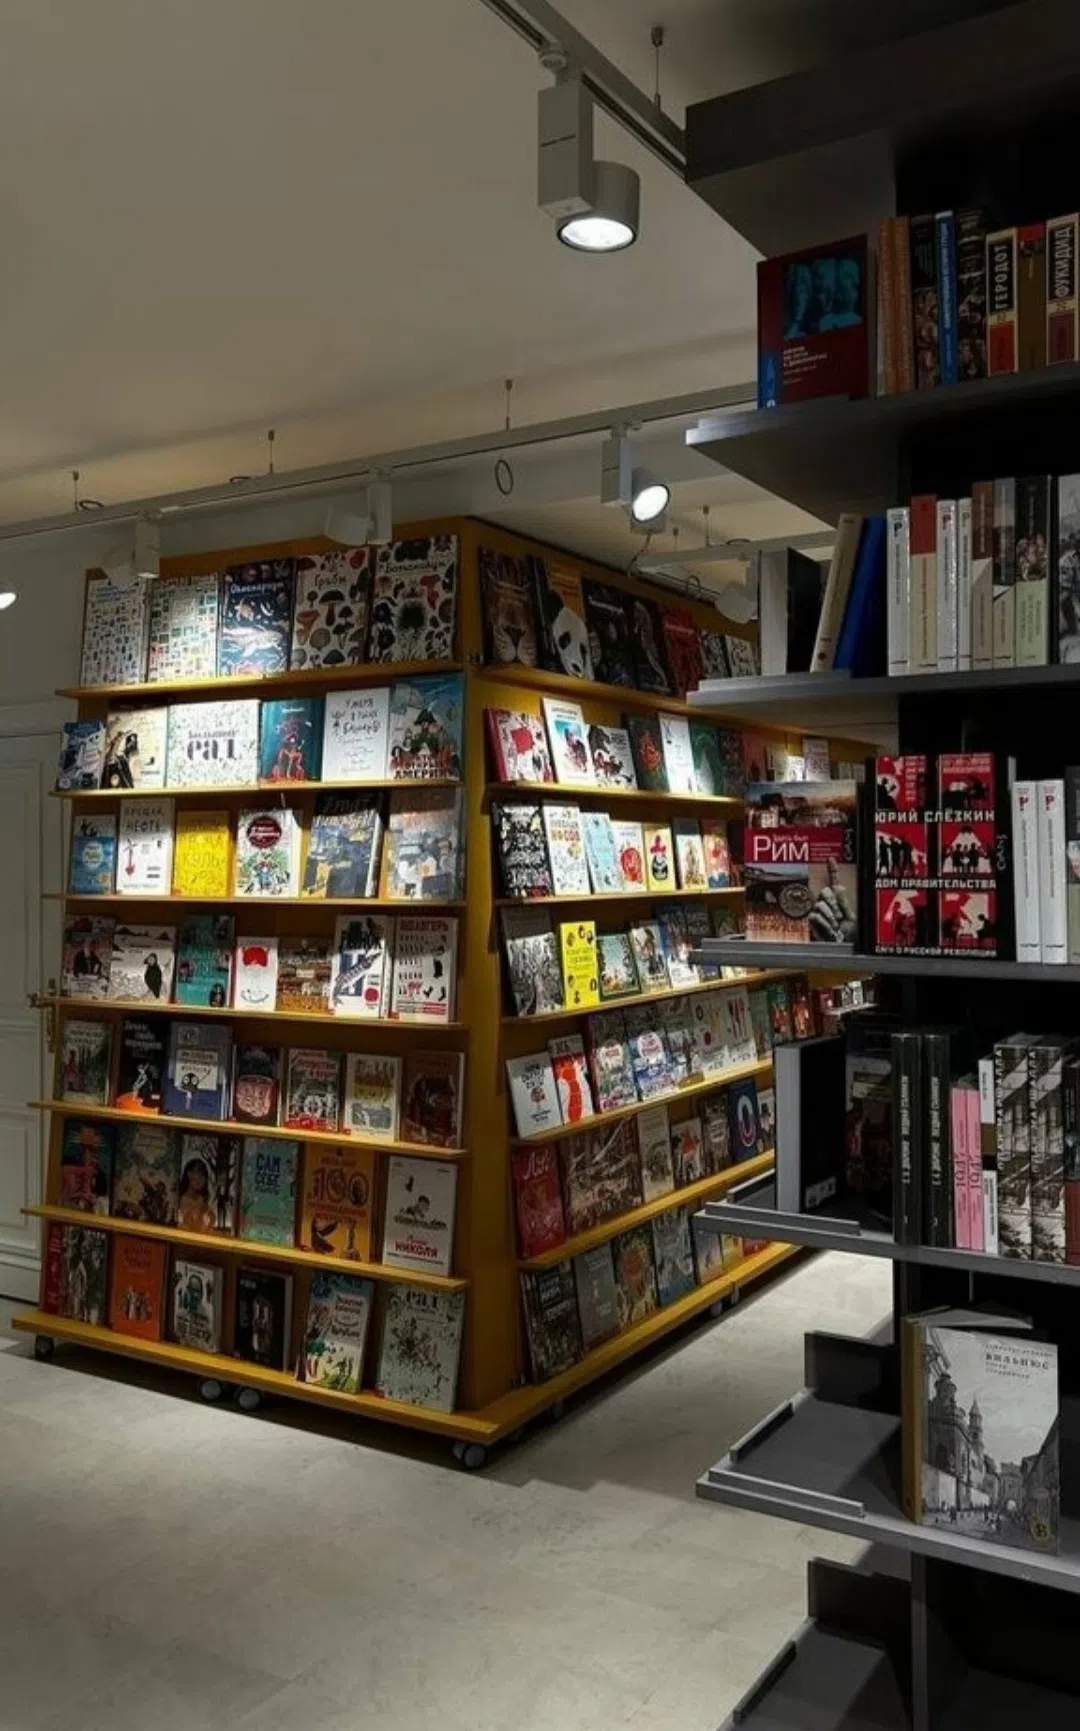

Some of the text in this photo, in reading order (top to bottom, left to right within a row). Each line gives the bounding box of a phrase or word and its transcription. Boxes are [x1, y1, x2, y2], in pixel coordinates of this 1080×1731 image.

[1053, 227, 1073, 298] ФУКИДИД
[994, 244, 1010, 310] ГЕРОДОТ
[875, 806, 995, 823] ЮРИЙ СЛЁЗКИН
[875, 879, 997, 889] ДОМ ПРАВИТЕЛЬСТВА
[395, 1241, 438, 1258] НИКОЛЯ
[986, 1353, 1049, 1370] ВИЛЬНЮС
